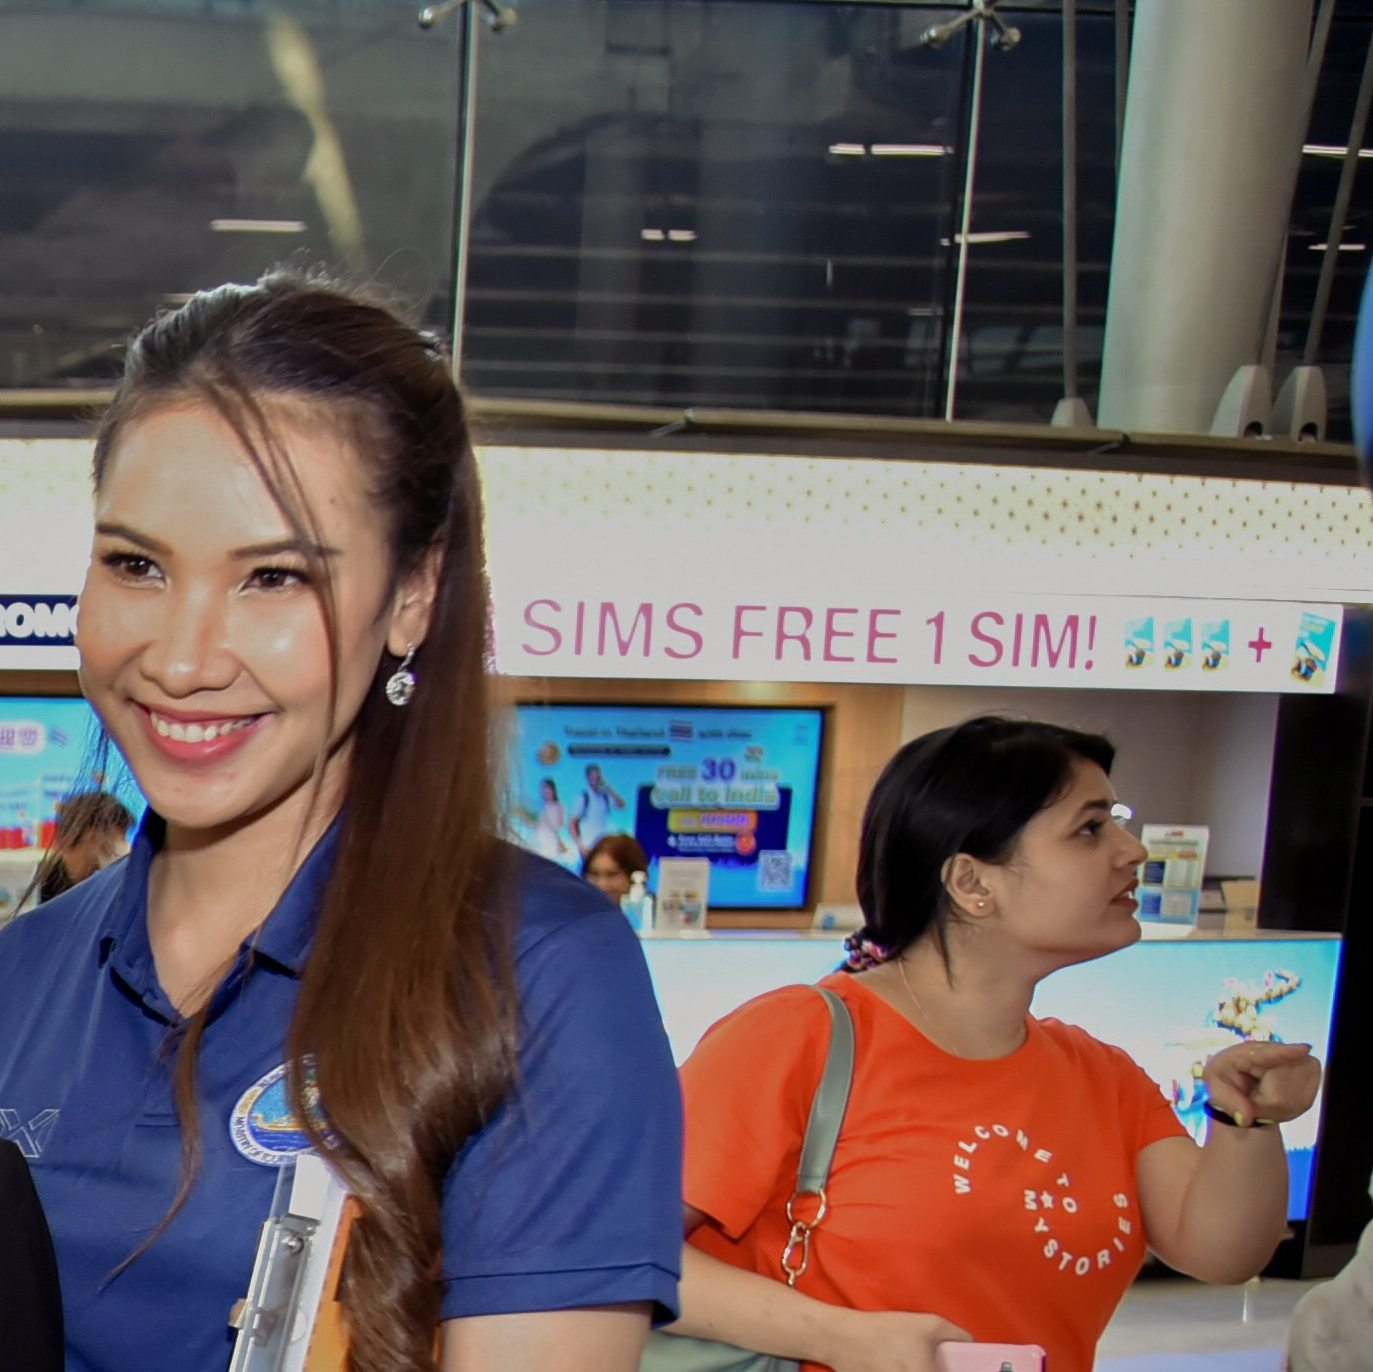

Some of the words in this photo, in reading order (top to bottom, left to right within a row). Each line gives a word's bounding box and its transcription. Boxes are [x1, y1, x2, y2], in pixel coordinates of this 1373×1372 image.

[521, 598, 704, 660] SIMS
[732, 604, 901, 664] FREE
[967, 611, 1097, 671] SIM!
[701, 758, 736, 781] 30
[726, 786, 777, 802] India
[953, 1124, 1053, 1194] WELCOME
[1043, 1192, 1132, 1275] STORIES
